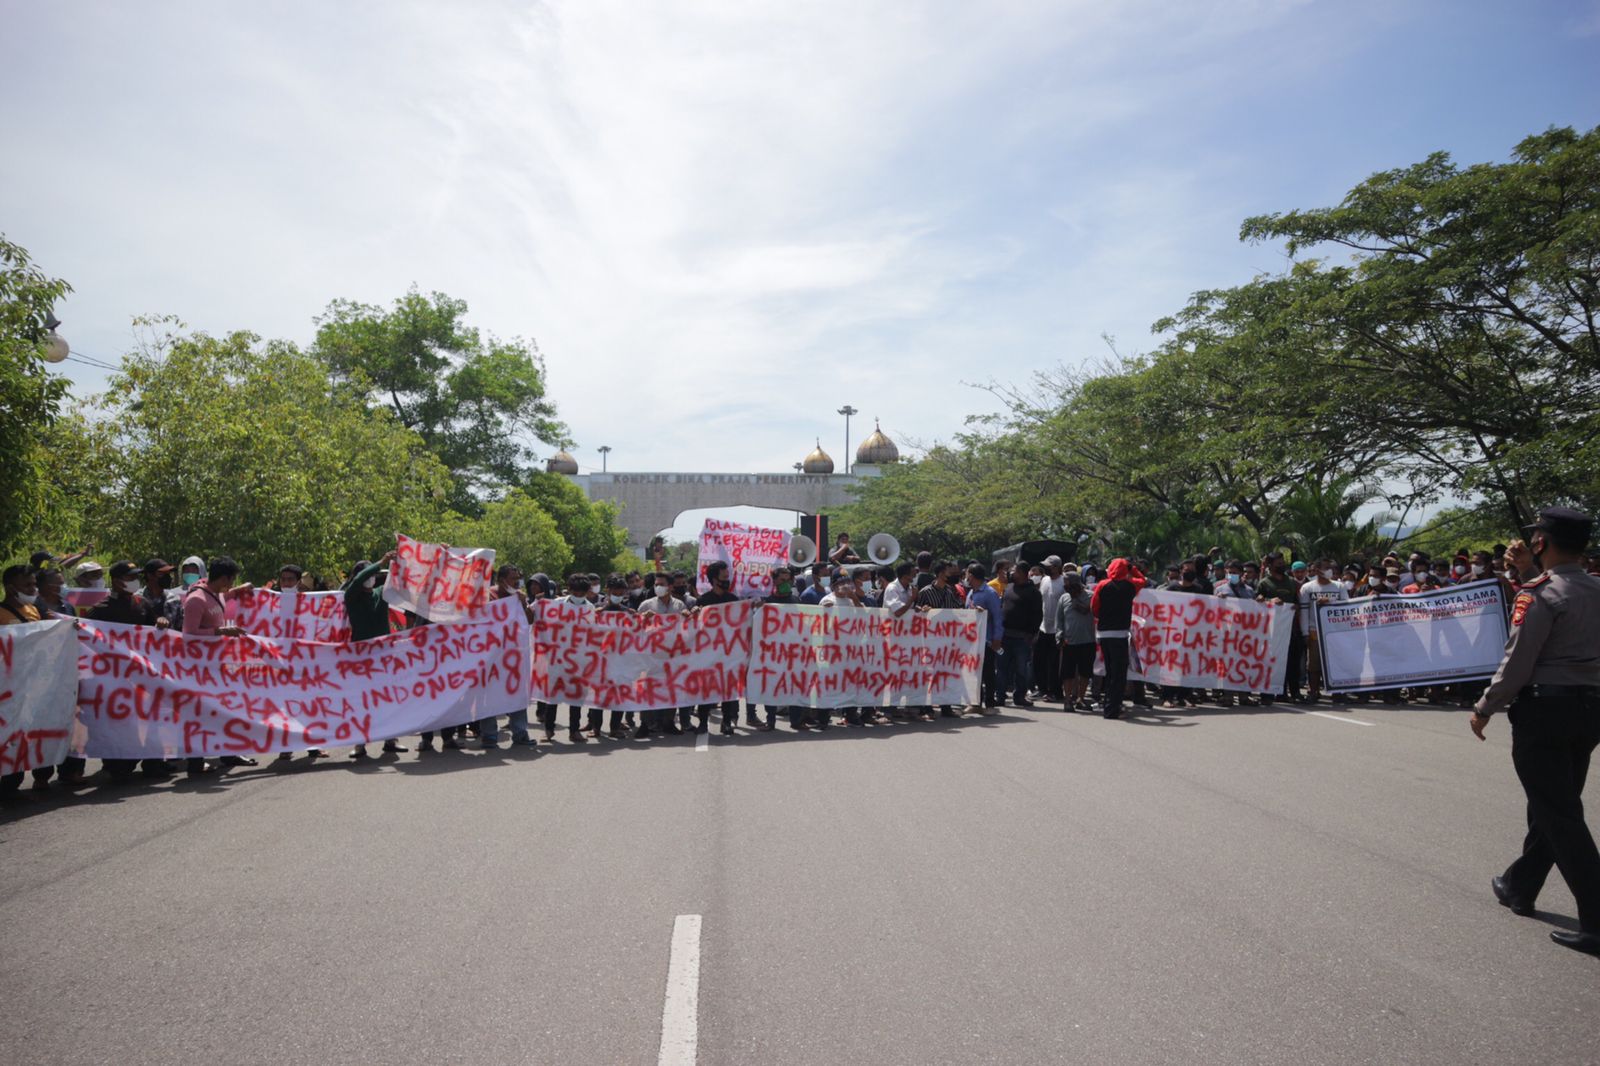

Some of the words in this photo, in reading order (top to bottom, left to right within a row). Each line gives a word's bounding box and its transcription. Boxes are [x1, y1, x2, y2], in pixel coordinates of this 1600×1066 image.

[1327, 607, 1360, 617] PETISI
[1363, 601, 1431, 614] MASYARAKAT
[1435, 596, 1463, 606] KOTA
[1466, 589, 1497, 601] LAMA
